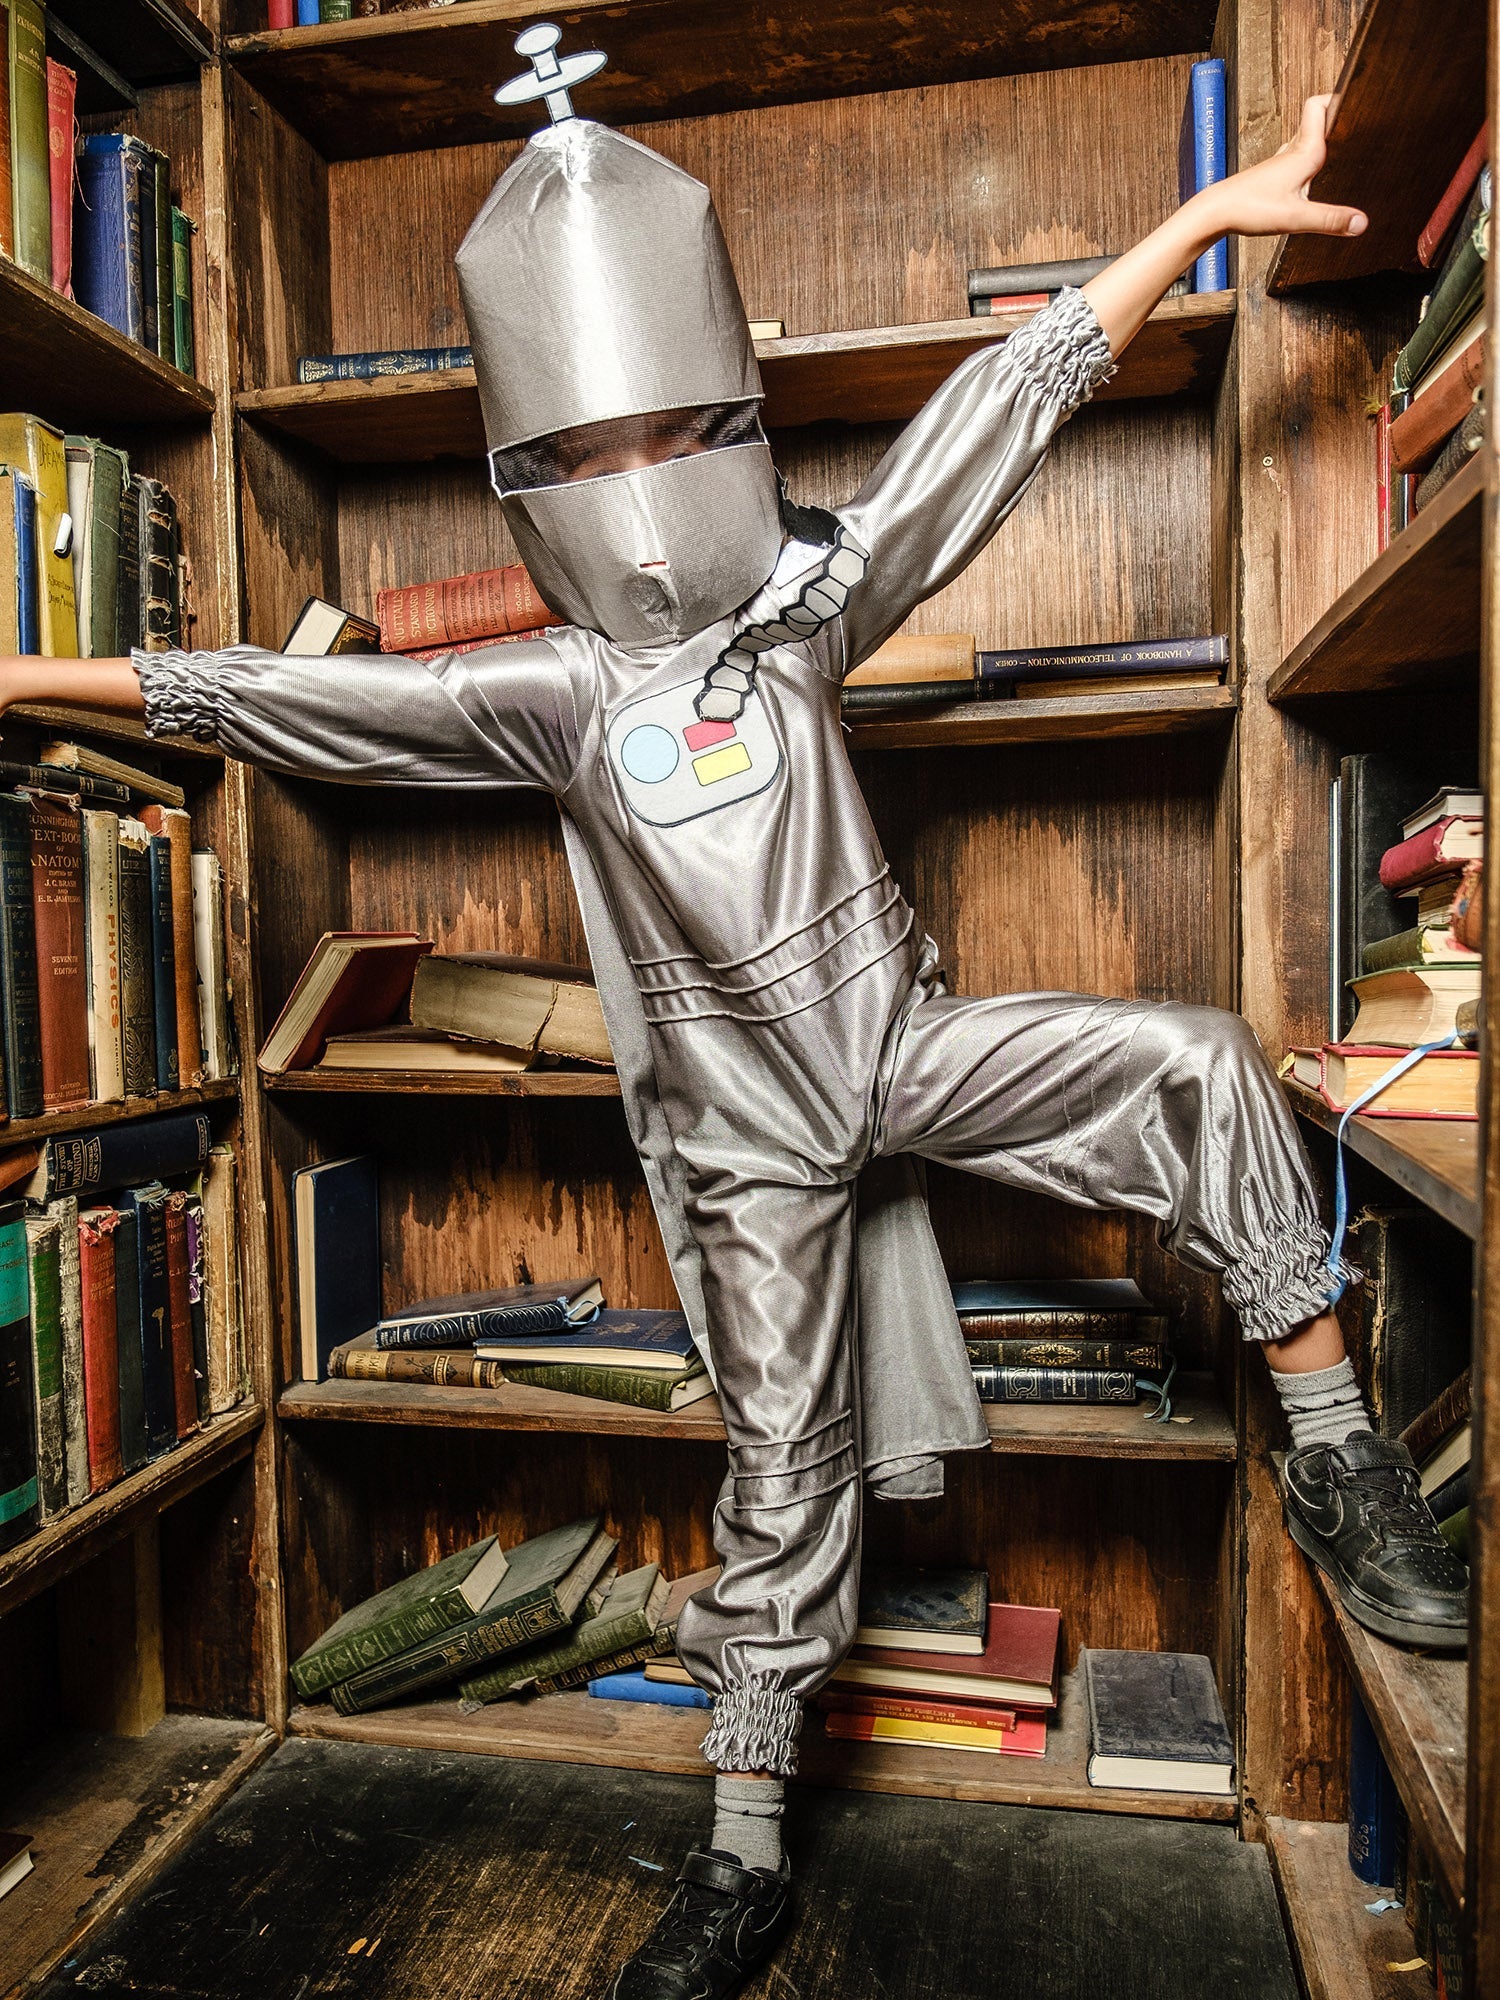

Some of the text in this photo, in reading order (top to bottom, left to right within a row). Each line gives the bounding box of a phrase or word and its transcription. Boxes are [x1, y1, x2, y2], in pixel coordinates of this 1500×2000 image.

[1205, 97, 1215, 187] ELECTRONIC BU
[1207, 246, 1216, 281] HINES
[410, 592, 422, 638] STANDARD
[425, 586, 438, 641] DICTIONARY
[1027, 652, 1115, 667] TELECOMMUNICATION
[1120, 652, 1132, 661] OF
[1136, 650, 1182, 661] HANDBOOK
[1186, 649, 1193, 657] A
[995, 660, 1018, 668] COHEN
[29, 814, 79, 828] UNNINGHAM
[30, 829, 80, 844] EXT-BOO
[56, 845, 64, 853] OF
[30, 854, 79, 869] NATOM
[54, 966, 78, 976] EDITION
[108, 914, 119, 1028] PHYSICS
[66, 1159, 73, 1172] OF
[72, 1142, 83, 1187] MANKIND
[352, 1352, 367, 1379] OUNG
